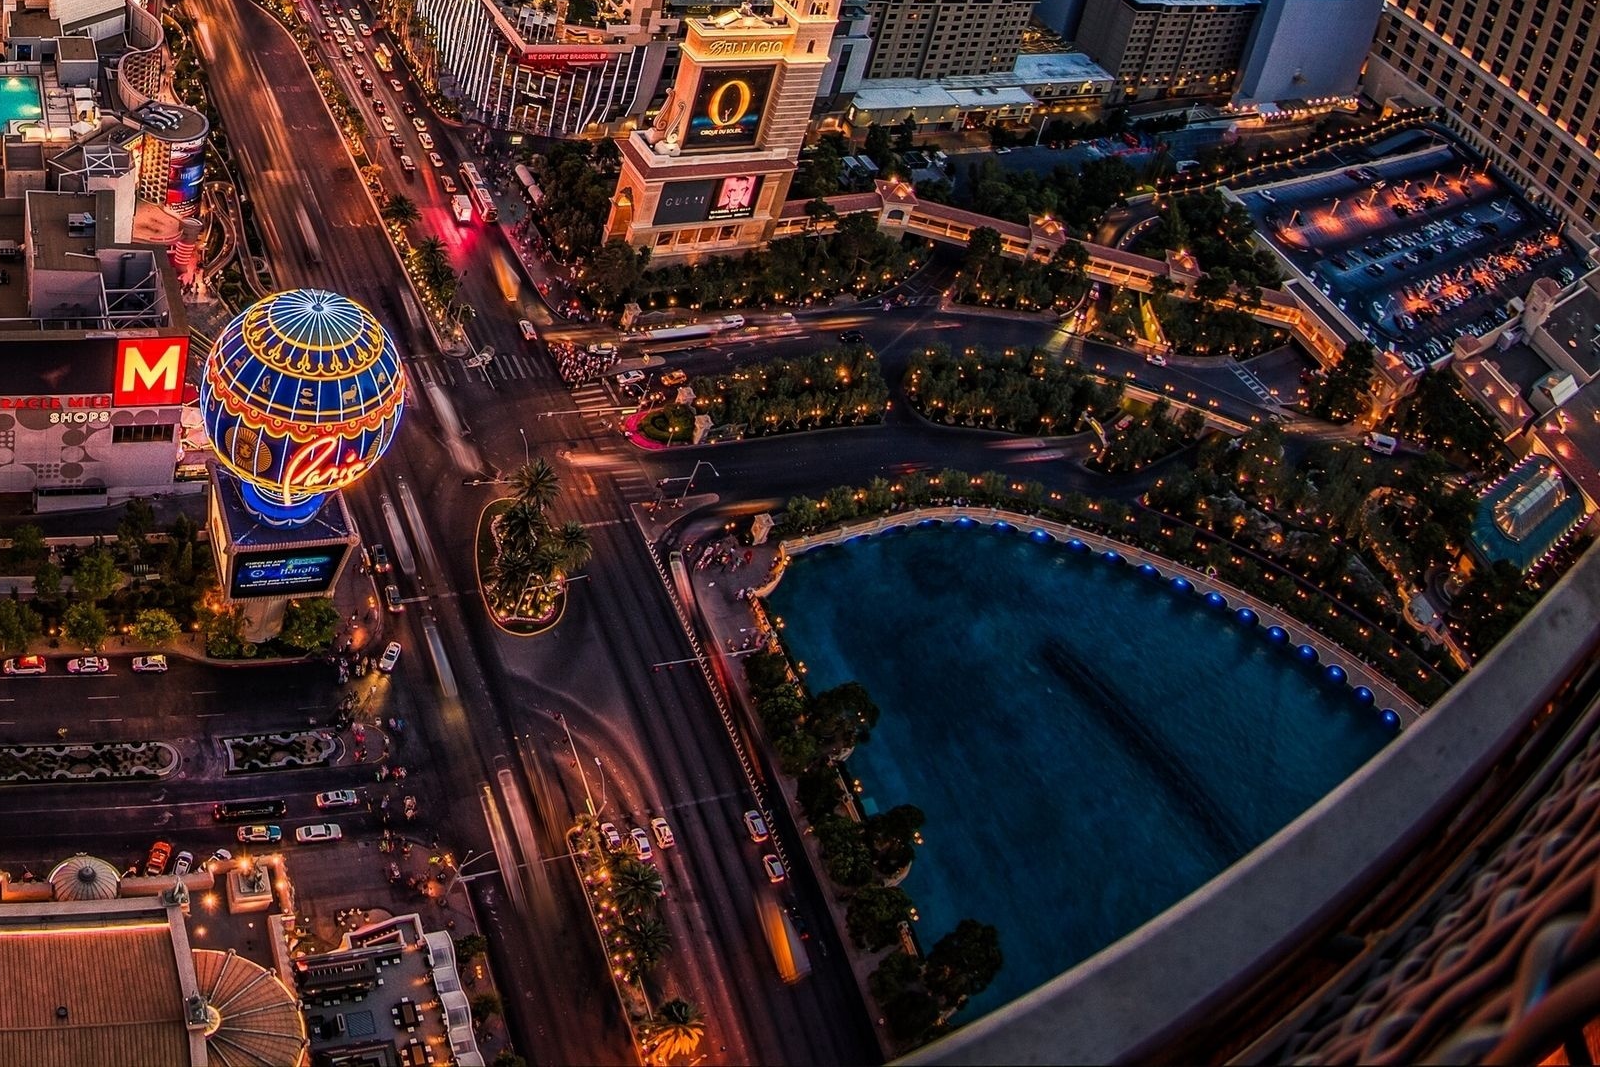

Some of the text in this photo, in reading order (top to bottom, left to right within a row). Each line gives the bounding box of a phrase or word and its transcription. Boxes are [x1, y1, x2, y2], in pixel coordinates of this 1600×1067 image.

[705, 40, 784, 56] BELLAGIO
[708, 80, 751, 126] O
[122, 345, 181, 392] M
[49, 411, 110, 424] SHOPS
[68, 395, 111, 409] MILE
[283, 436, 367, 505] Paris
